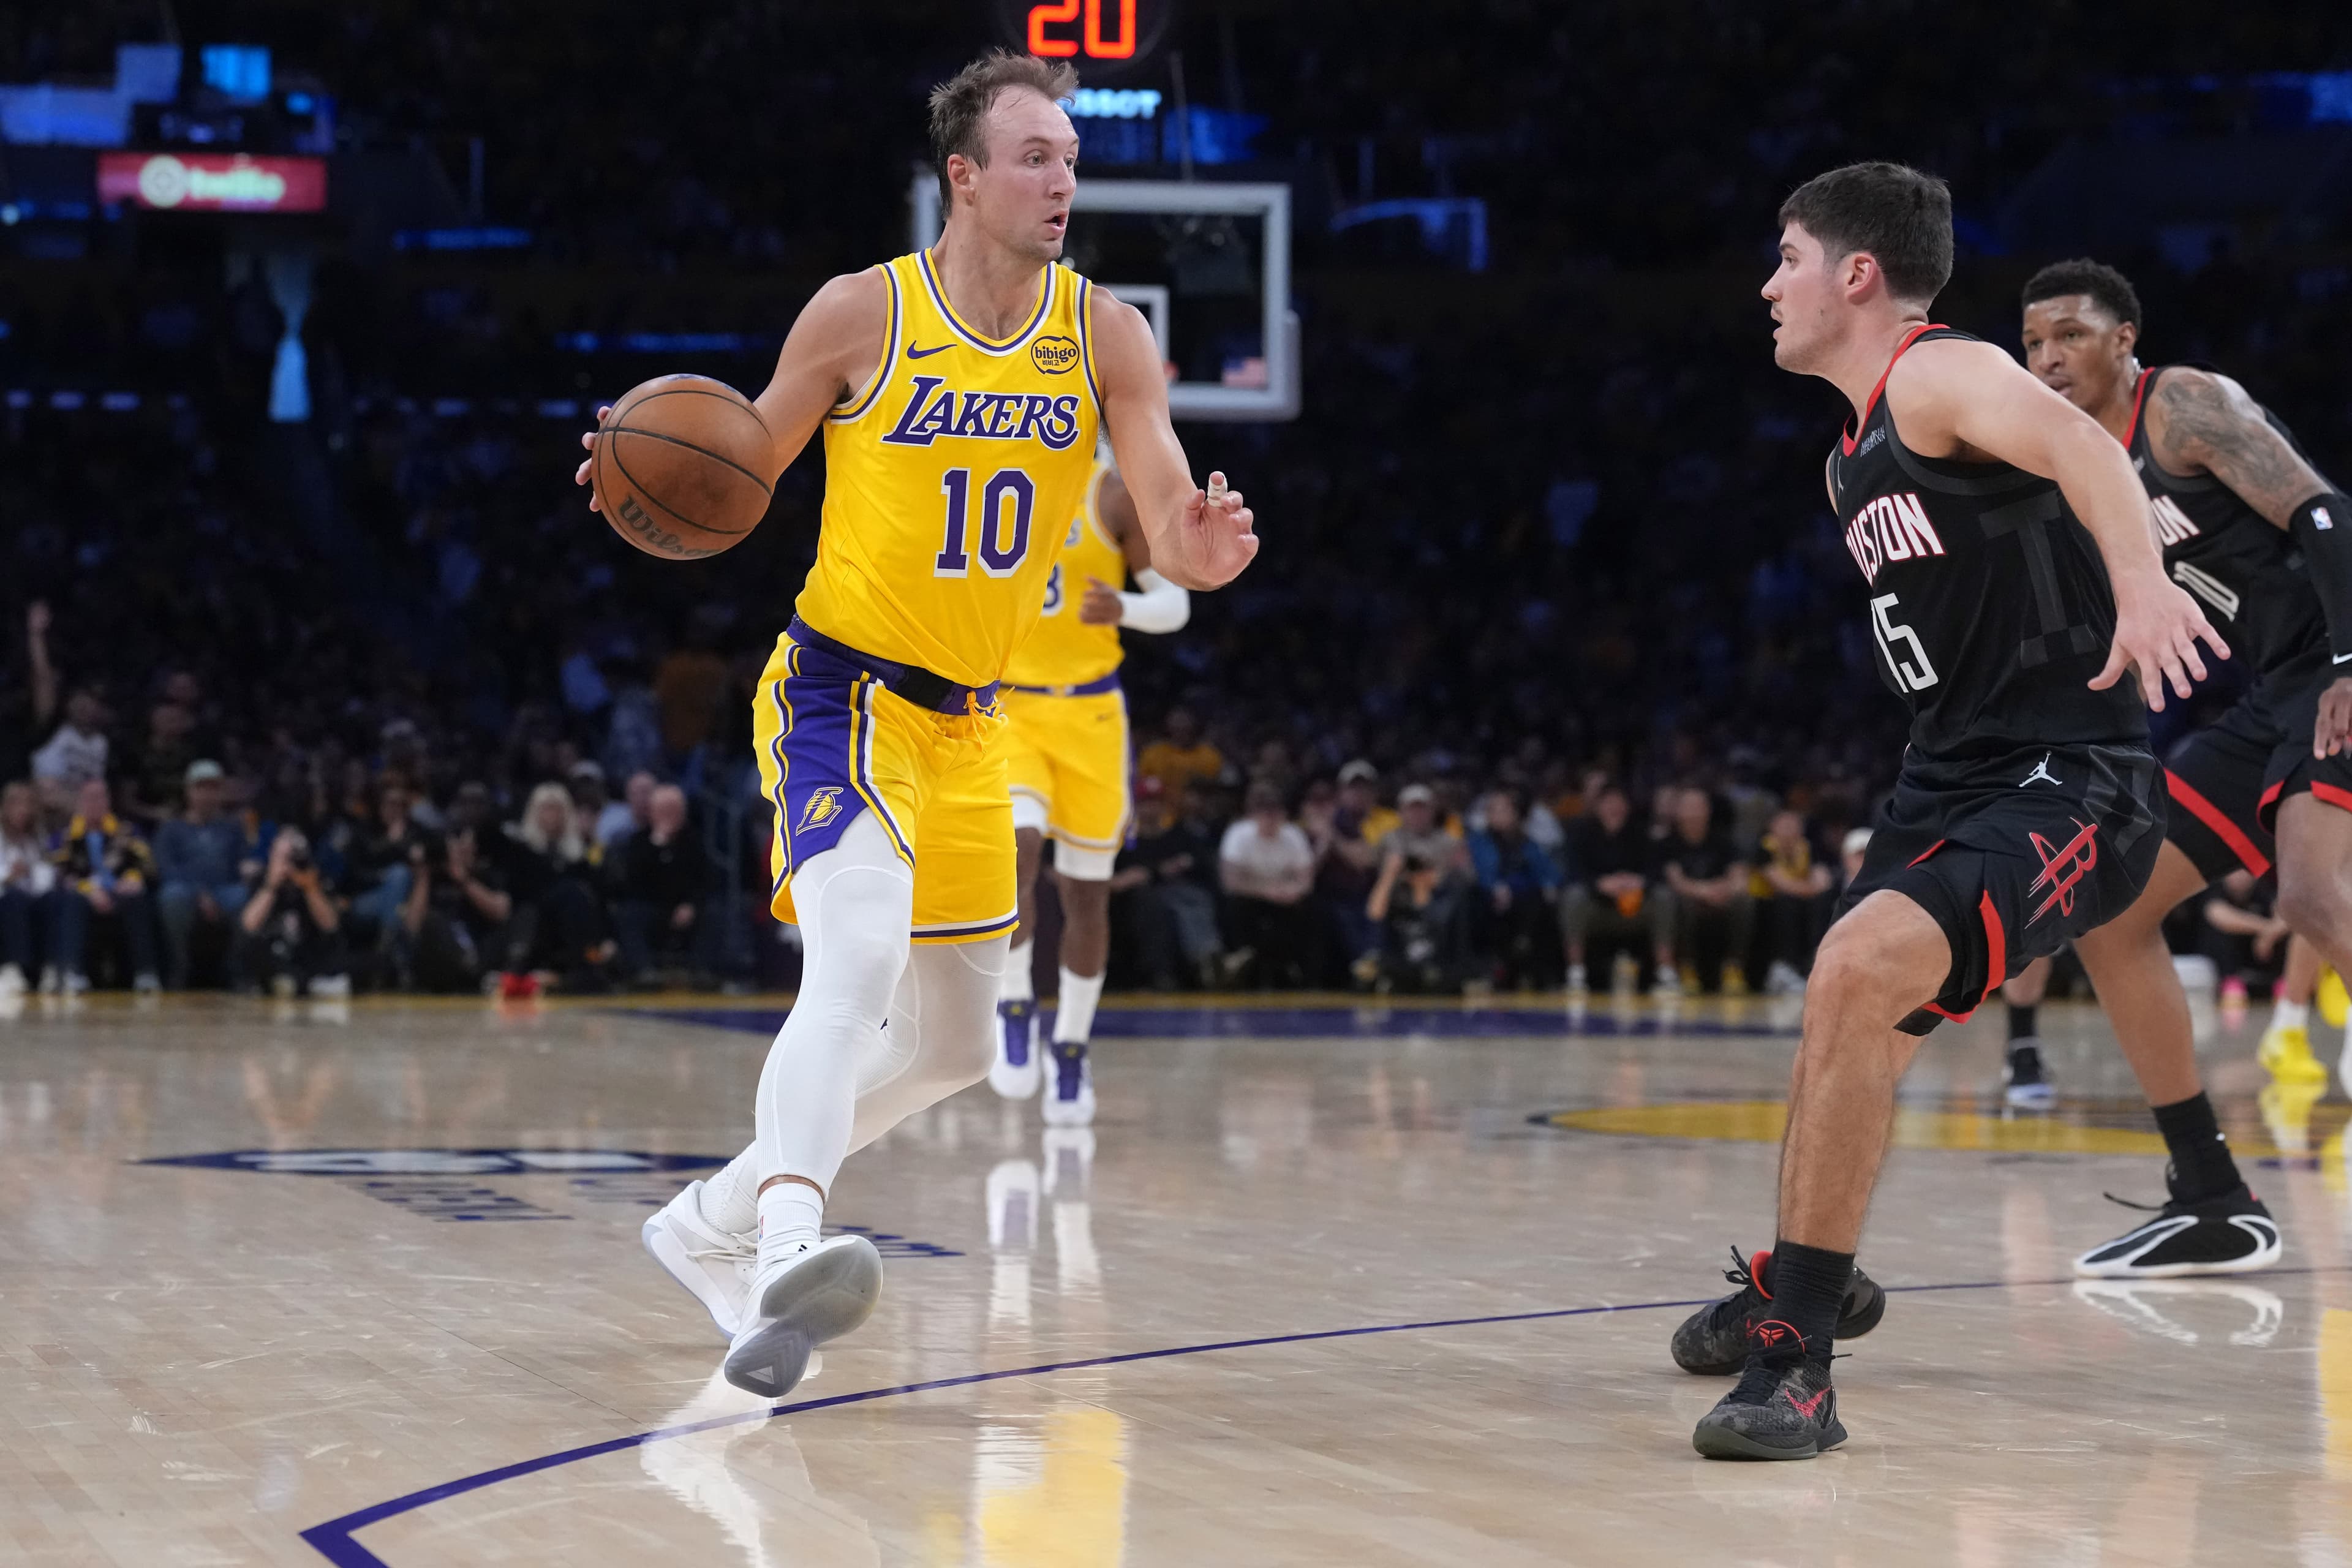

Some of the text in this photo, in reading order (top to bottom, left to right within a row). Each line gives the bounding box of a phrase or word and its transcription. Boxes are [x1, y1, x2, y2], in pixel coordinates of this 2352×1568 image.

[1028, 0, 1136, 58] 20
[1035, 345, 1077, 363] bibigo
[933, 466, 1036, 579] 10
